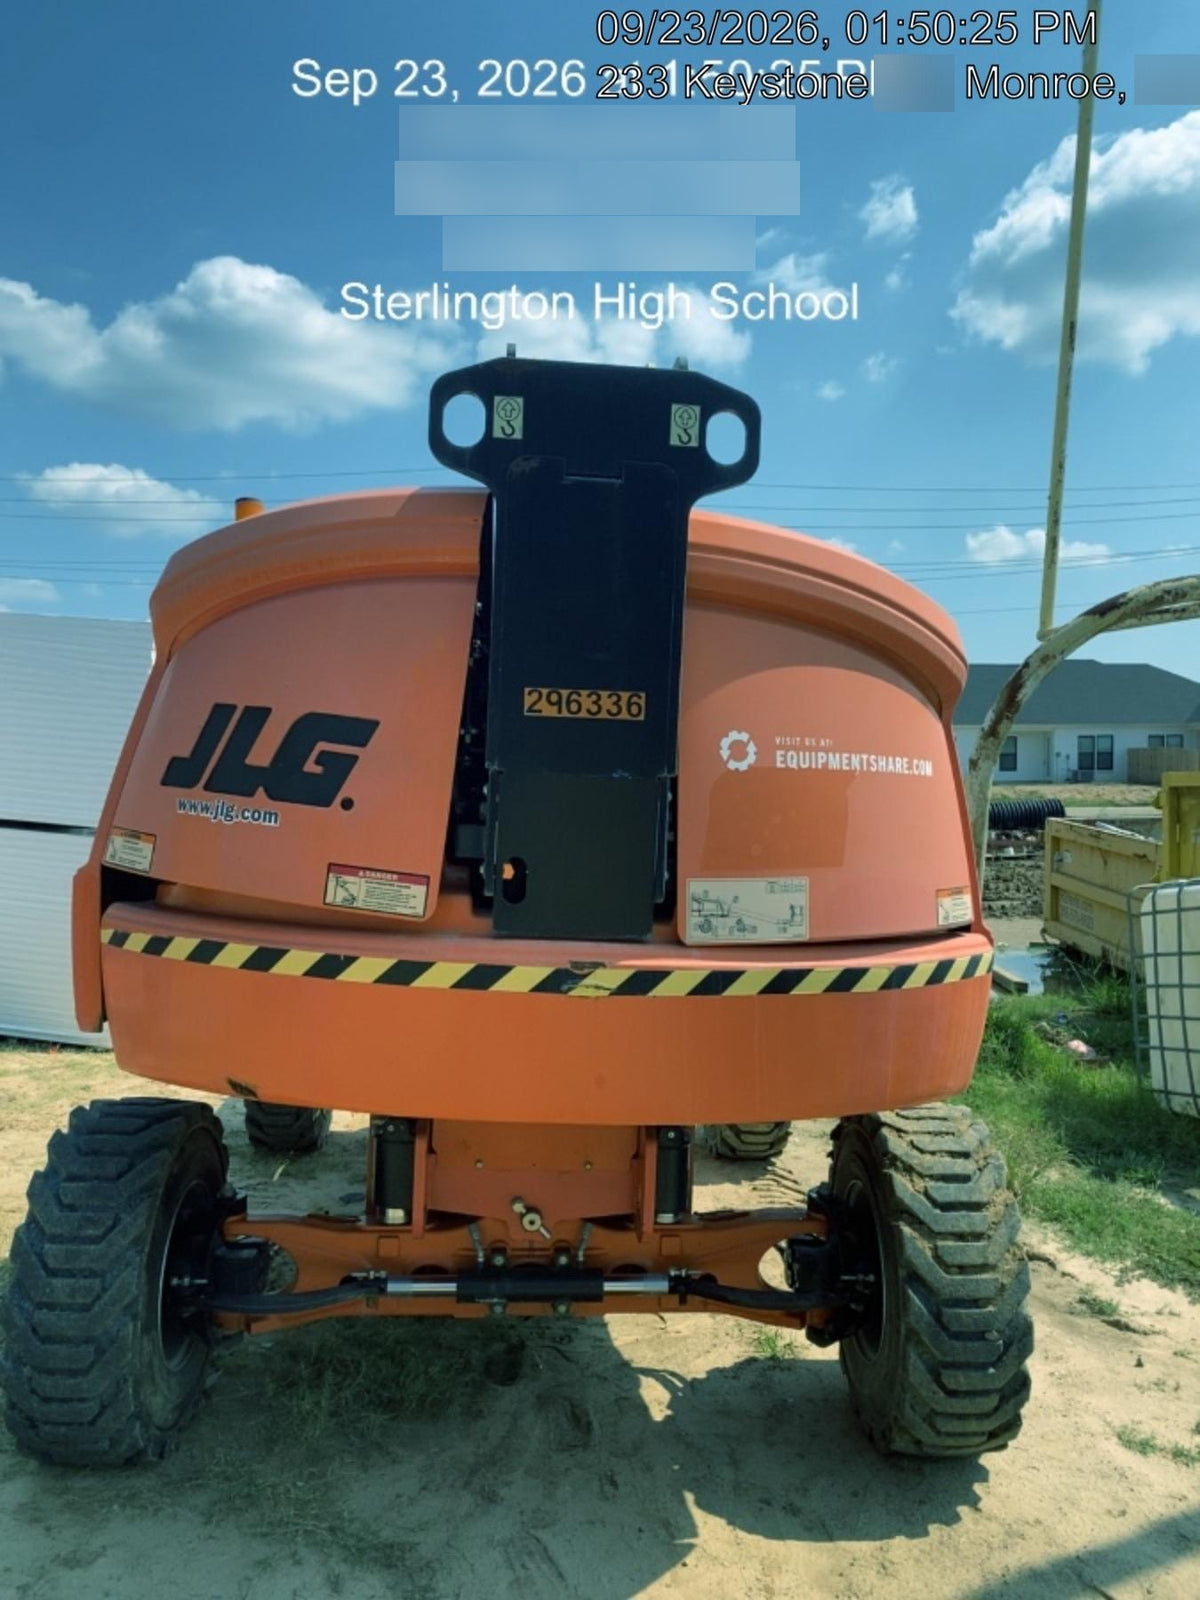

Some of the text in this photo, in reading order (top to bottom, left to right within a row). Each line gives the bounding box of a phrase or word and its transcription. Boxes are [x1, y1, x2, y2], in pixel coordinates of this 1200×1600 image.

[526, 688, 644, 718] 296336
[775, 736, 801, 746] VISIT
[775, 750, 933, 777] EQUIPMENTSHARE.COM
[177, 798, 280, 826] www.jlg.com
